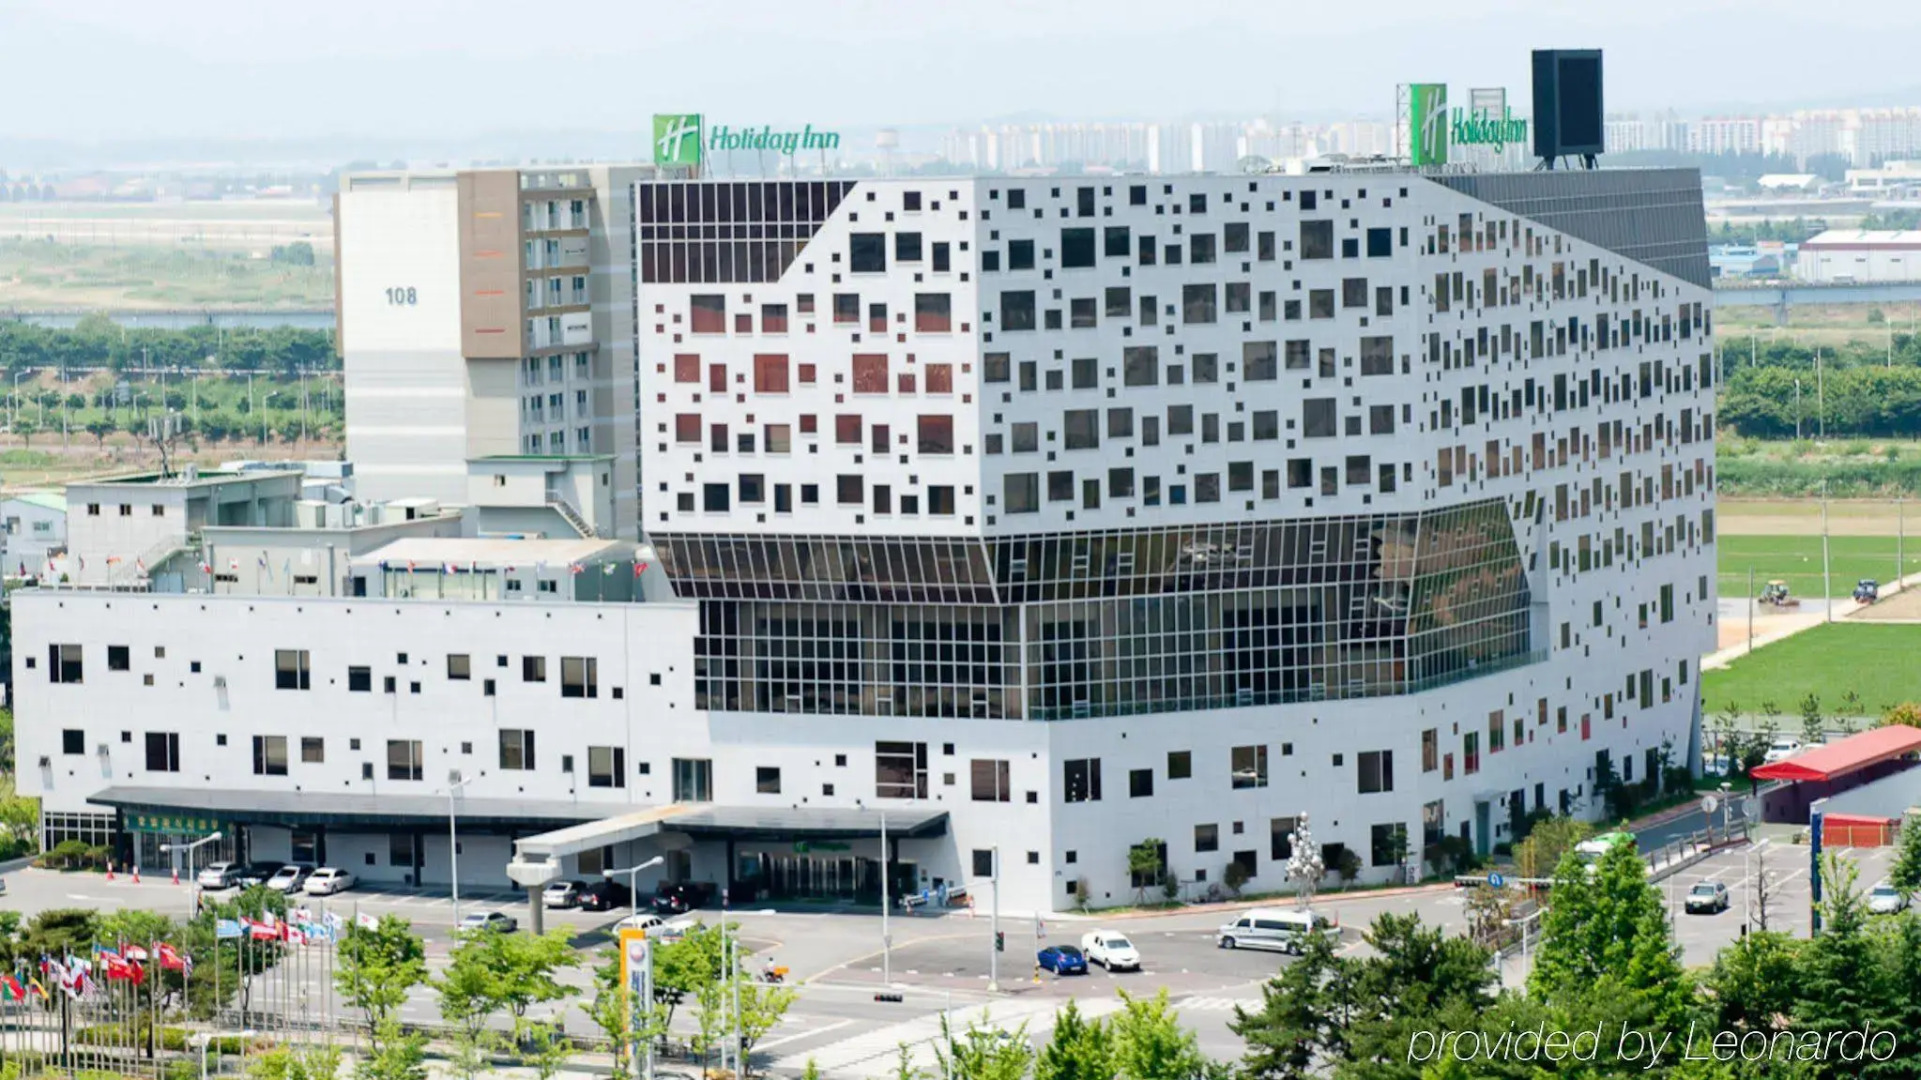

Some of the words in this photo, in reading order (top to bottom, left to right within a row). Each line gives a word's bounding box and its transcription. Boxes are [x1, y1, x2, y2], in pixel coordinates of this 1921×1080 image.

[710, 125, 798, 155] Holiday
[802, 124, 840, 149] Inn
[1451, 107, 1504, 153] Holiday
[1505, 105, 1527, 143] Inn
[385, 286, 417, 305] 108
